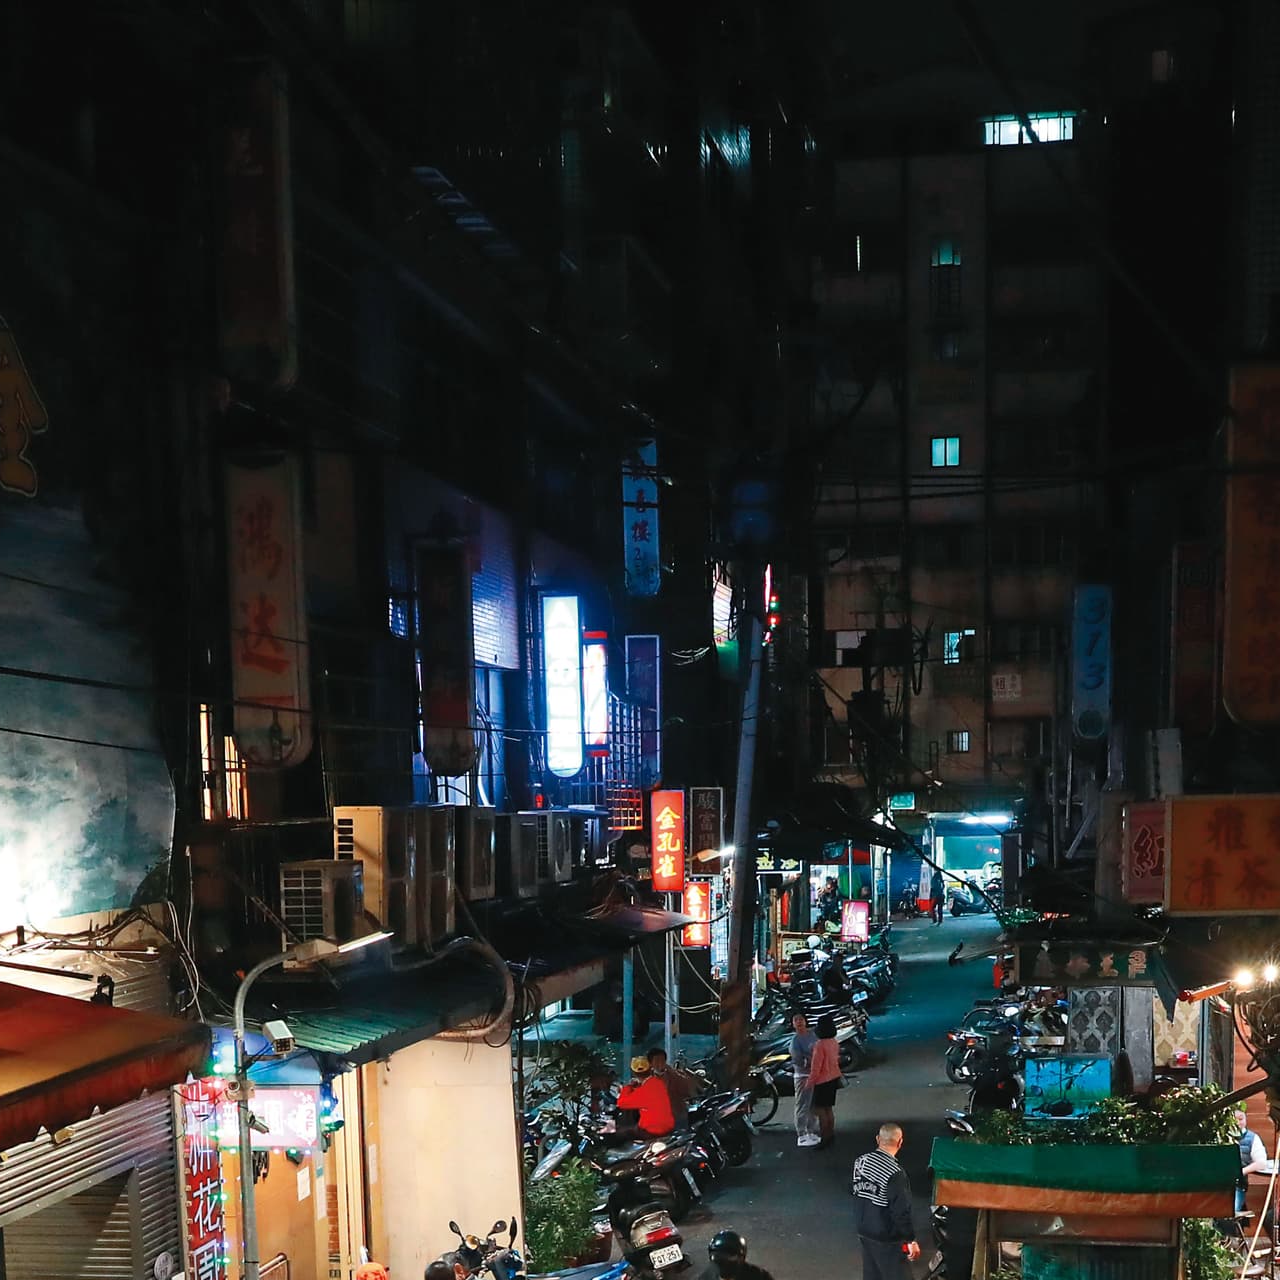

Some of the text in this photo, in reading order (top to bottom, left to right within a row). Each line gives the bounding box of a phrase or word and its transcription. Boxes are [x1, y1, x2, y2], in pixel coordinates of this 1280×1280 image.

[655, 806, 681, 878] 金孔雀
[685, 884, 707, 941] 金孔雀
